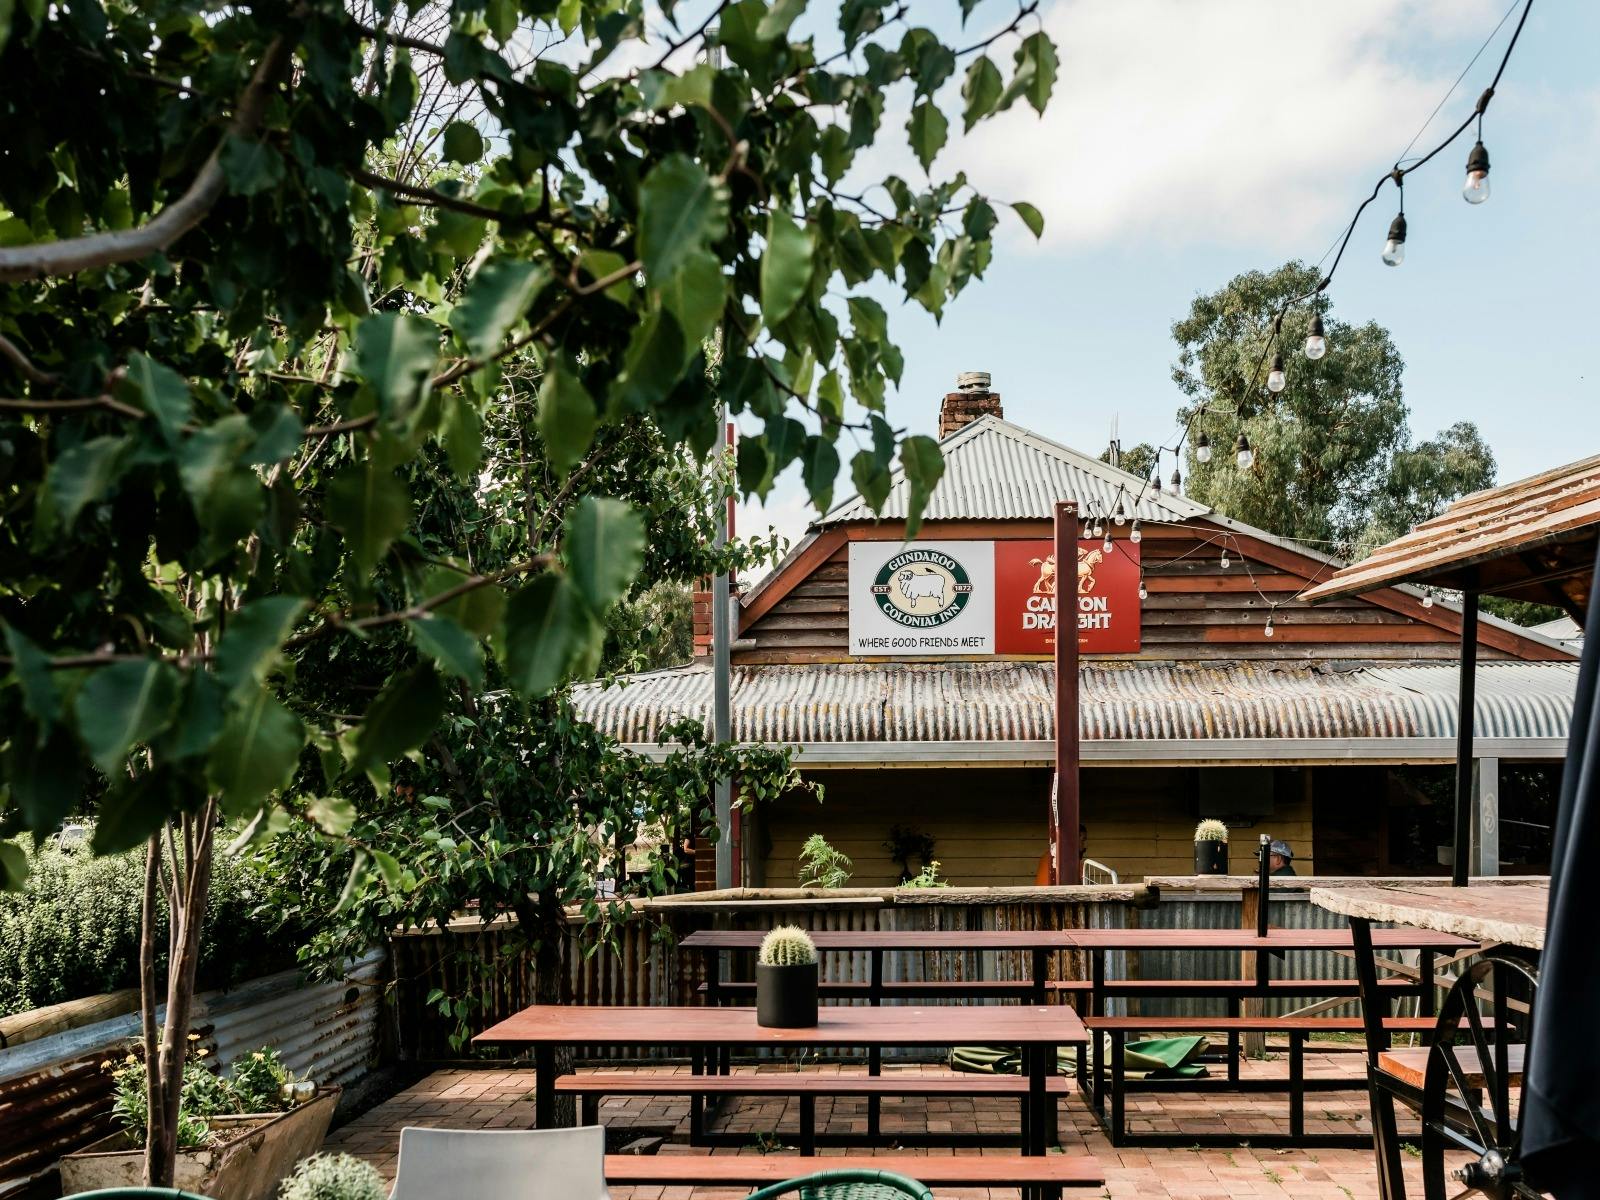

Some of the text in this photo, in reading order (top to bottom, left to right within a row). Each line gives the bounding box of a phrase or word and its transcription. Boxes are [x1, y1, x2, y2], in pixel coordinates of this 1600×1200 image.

[888, 551, 956, 571] GUNDAROO
[1026, 595, 1108, 612] CAON
[883, 602, 961, 627] COLONIAL INN
[1022, 612, 1112, 630] DRAGHT
[858, 637, 986, 648] WHERE GOOD FRIENDS MEET
